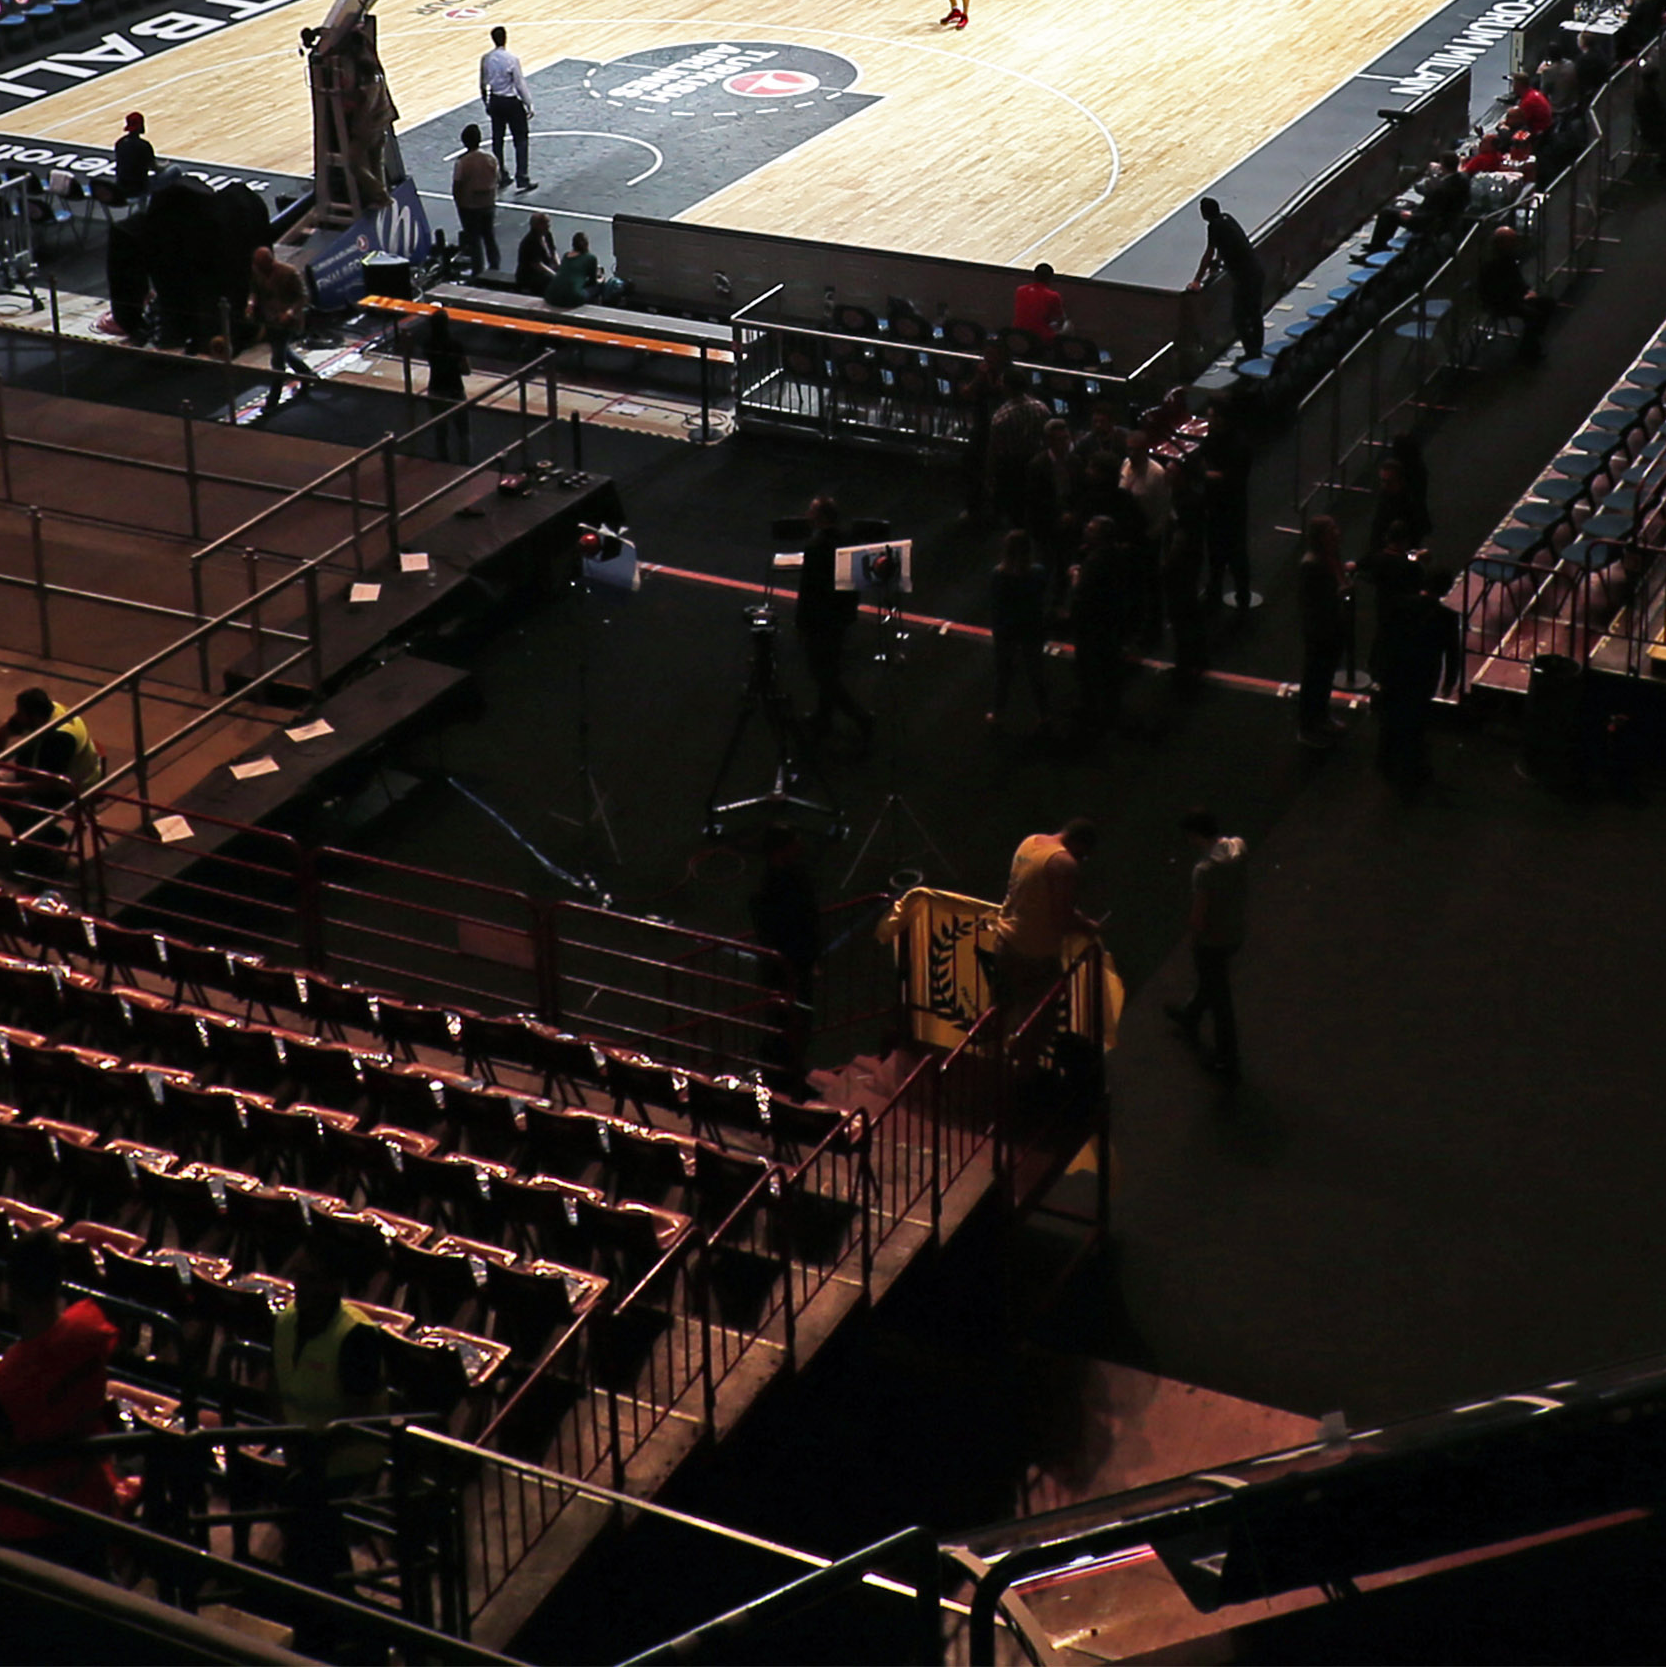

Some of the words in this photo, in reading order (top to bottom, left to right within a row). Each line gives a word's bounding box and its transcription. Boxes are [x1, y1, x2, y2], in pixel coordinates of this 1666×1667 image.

[607, 42, 742, 99] AIRLINES
[639, 49, 780, 103] TURKISH
[1390, 44, 1487, 96] MILAN
